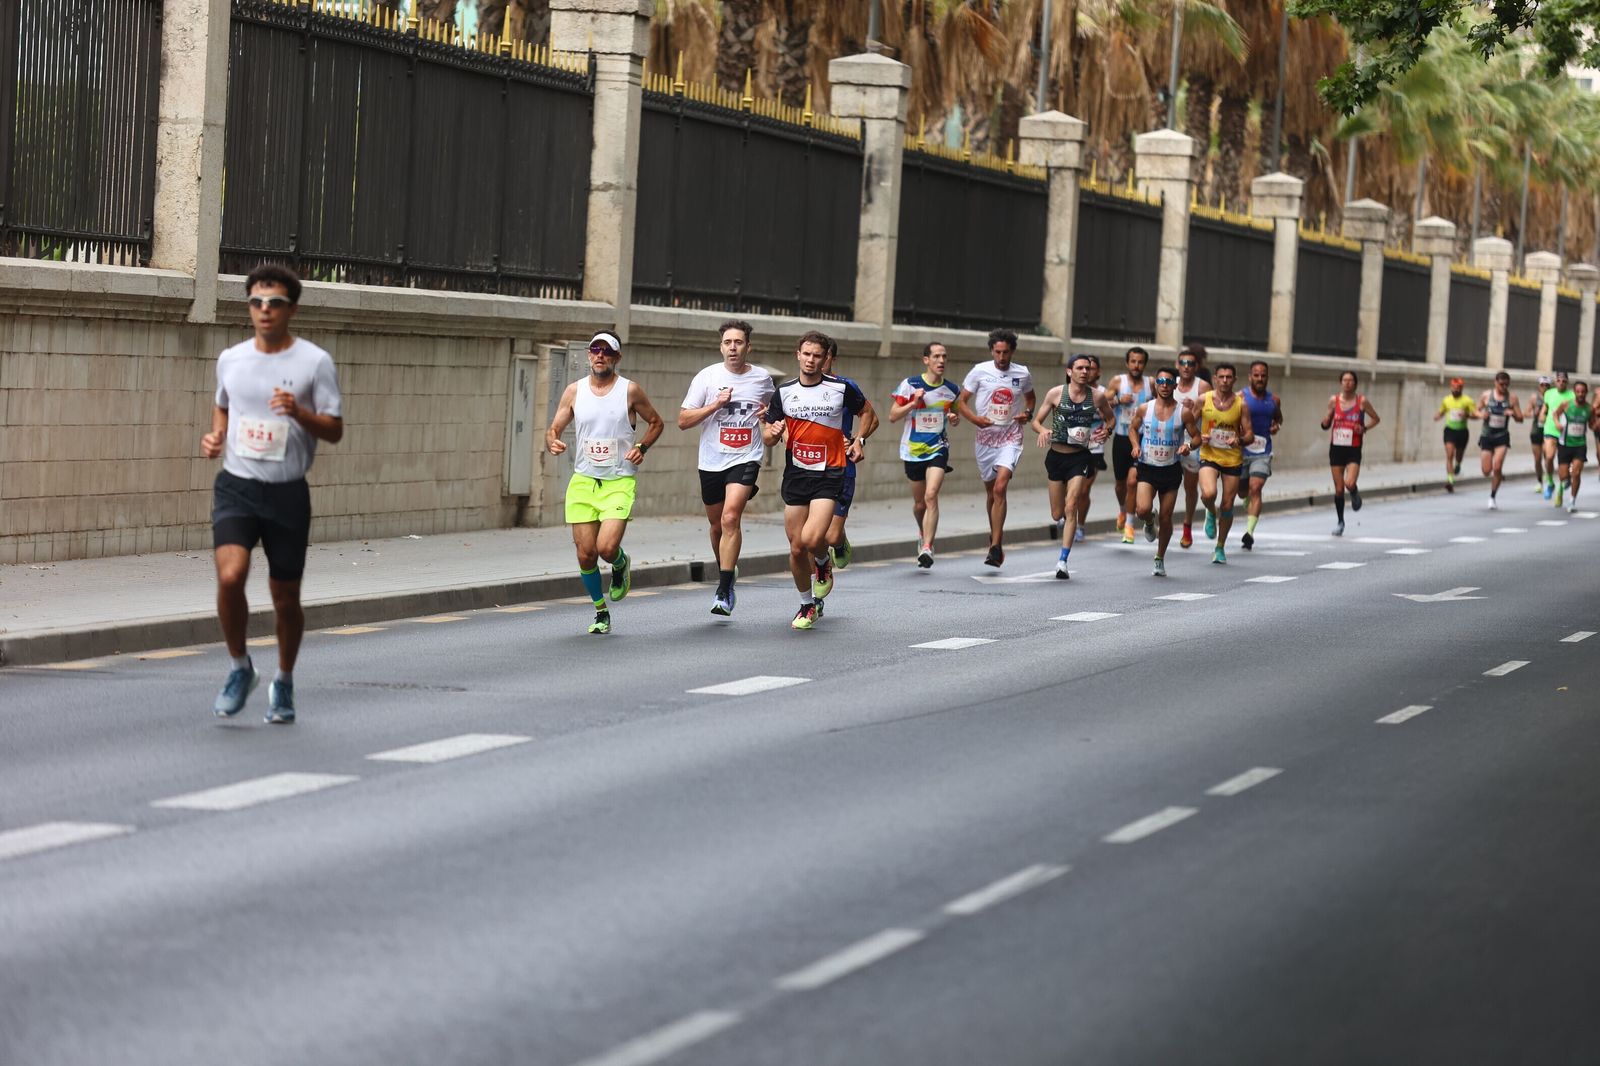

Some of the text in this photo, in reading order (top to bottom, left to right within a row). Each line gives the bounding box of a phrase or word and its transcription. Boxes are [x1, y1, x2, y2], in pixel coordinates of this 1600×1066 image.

[723, 433, 749, 441] 2713
[590, 446, 609, 454] 132
[796, 449, 822, 459] 2183
